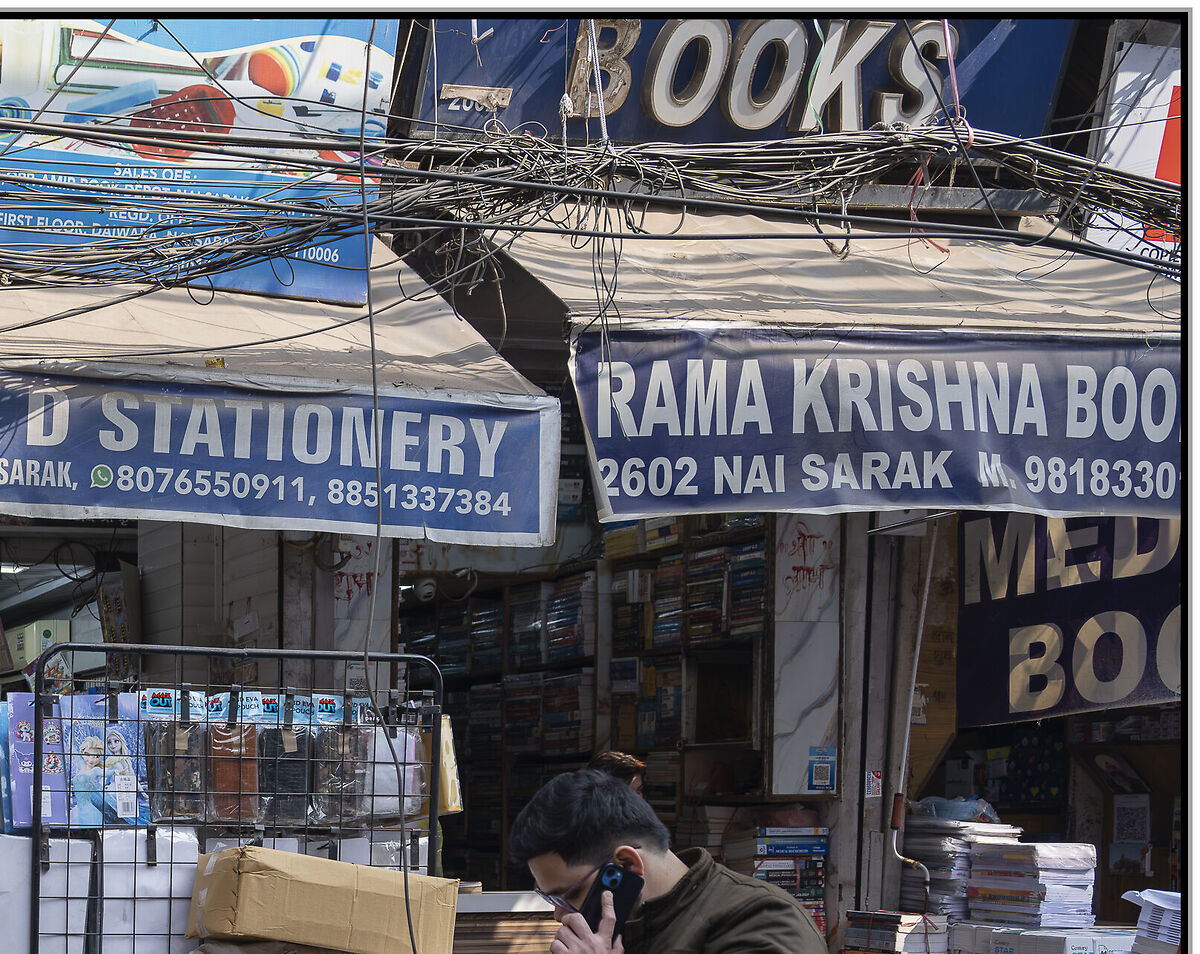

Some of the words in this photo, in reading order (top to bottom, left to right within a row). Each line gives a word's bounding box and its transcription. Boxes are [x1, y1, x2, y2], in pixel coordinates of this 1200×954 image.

[568, 19, 960, 131] BOOKS
[113, 162, 158, 179] SALES
[597, 359, 774, 438] RAMA
[792, 358, 1048, 438] KRISHNA
[1064, 365, 1181, 444] BOO
[26, 389, 70, 448] D
[99, 396, 509, 478] STATIONERY
[116, 465, 316, 508] 8076550911,
[327, 478, 512, 516] 8851337384
[599, 456, 699, 497] 2602
[713, 454, 786, 496] NAI
[801, 450, 954, 492] SARAK
[1025, 455, 1181, 501] 9818330
[150, 697, 172, 708] OUT
